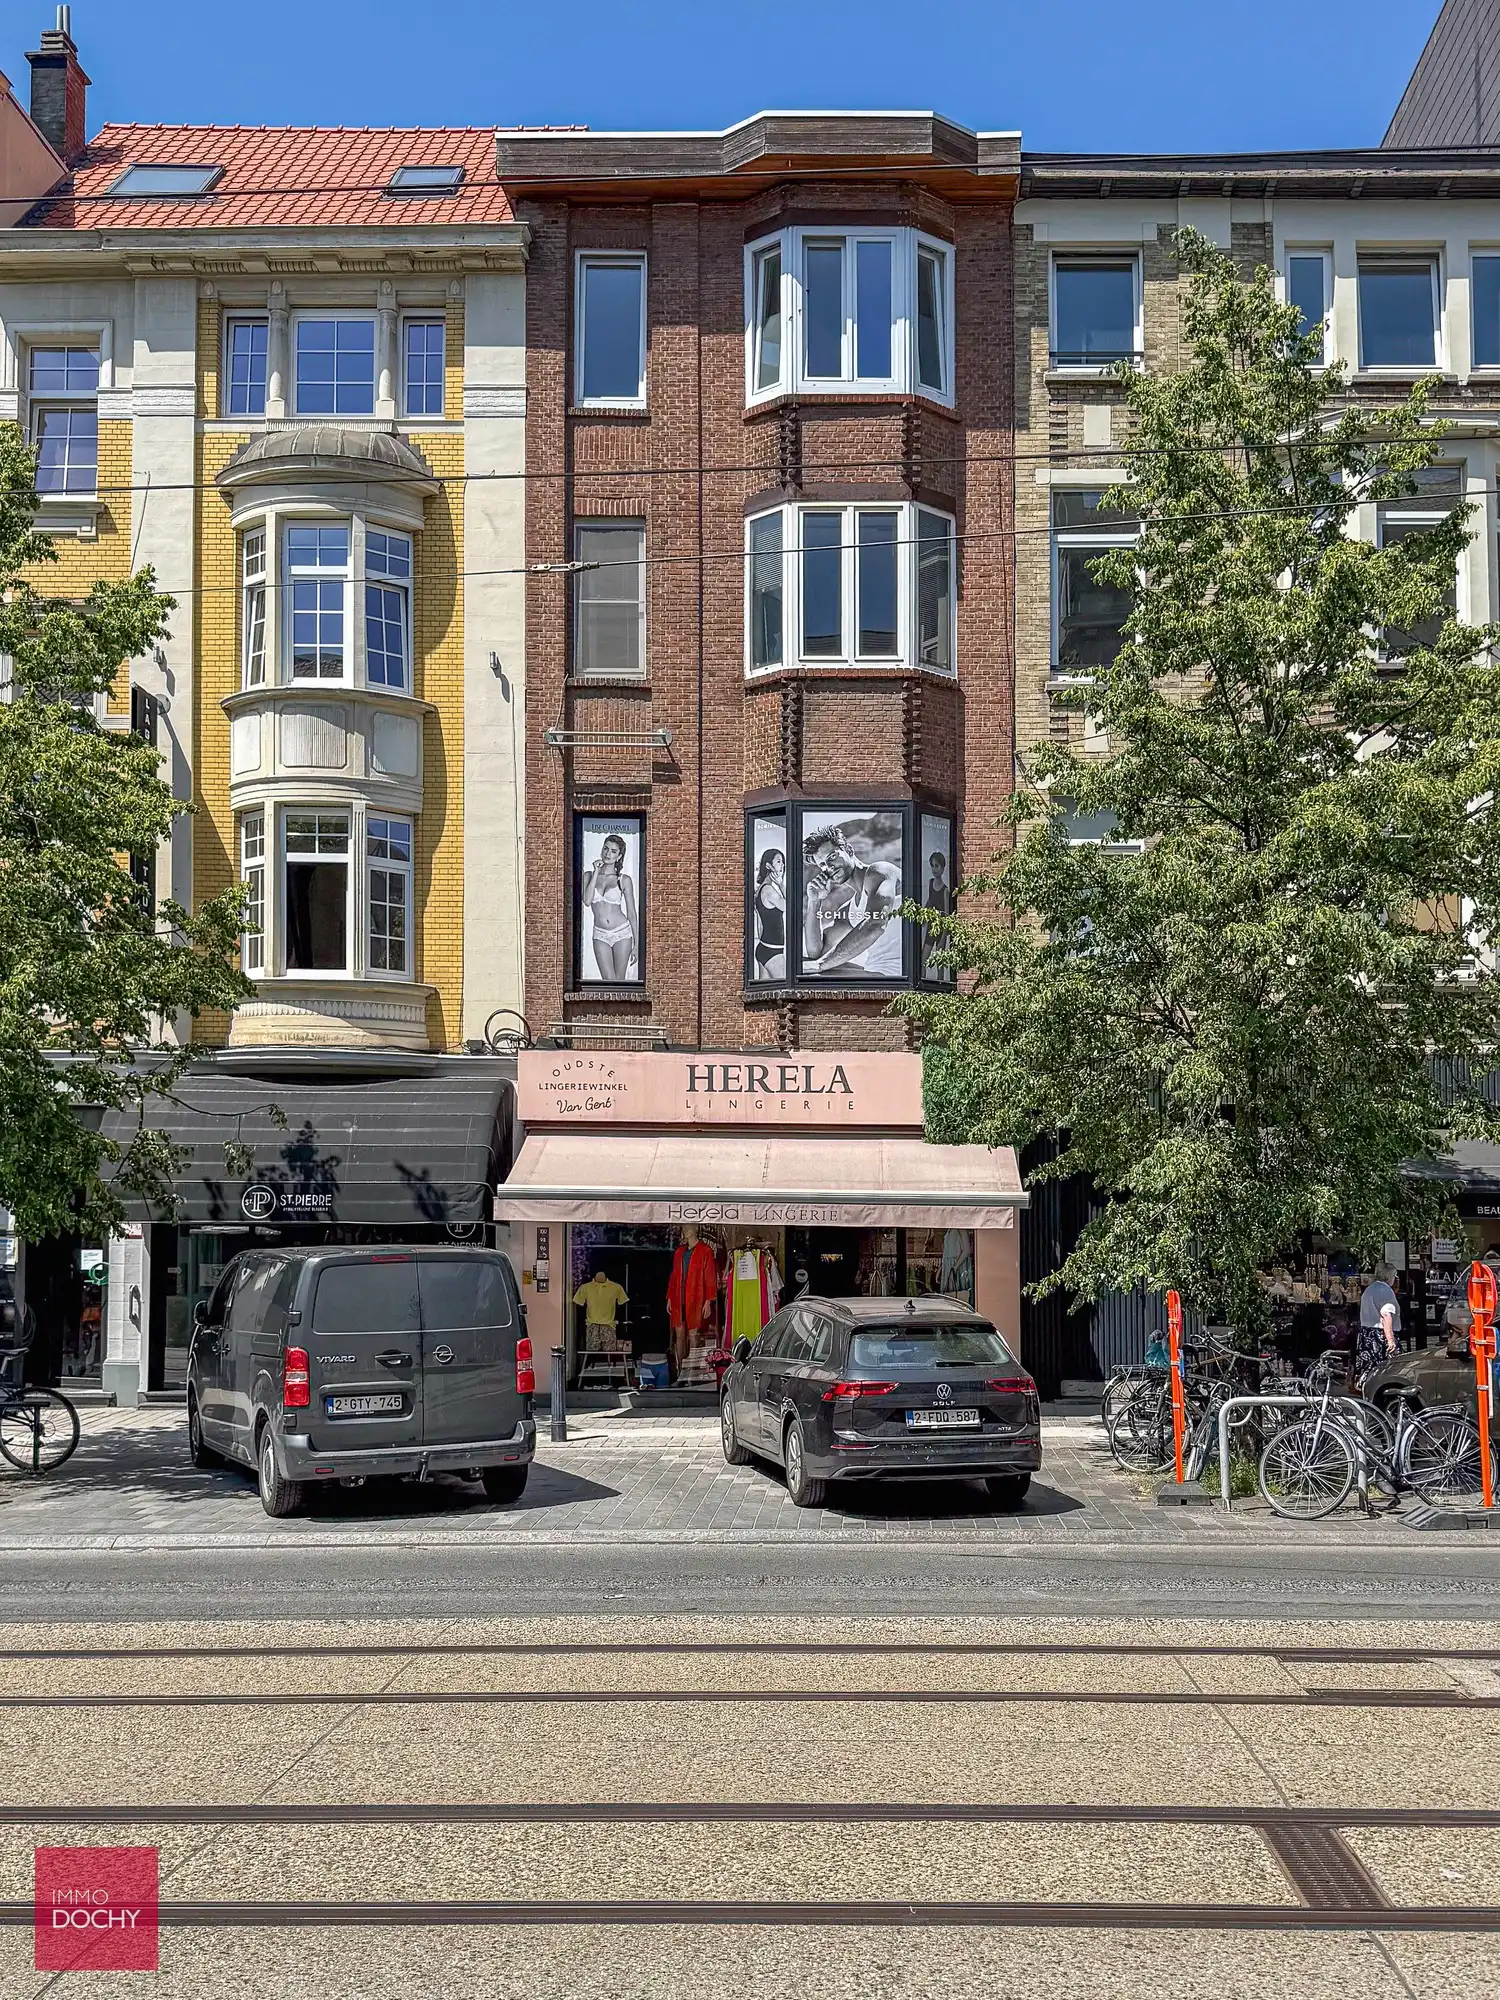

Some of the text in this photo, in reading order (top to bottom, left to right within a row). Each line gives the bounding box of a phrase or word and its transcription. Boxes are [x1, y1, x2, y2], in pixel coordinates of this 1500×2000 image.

[552, 1060, 615, 1078] OUDSTE
[539, 1083, 628, 1091] LINGERIEWINKEL
[686, 1064, 854, 1094] HERELA
[556, 1096, 612, 1114] Van Gent
[686, 1100, 854, 1110] LINGERIE
[668, 1205, 838, 1222] Herela LINGERIE
[316, 1355, 356, 1363] VIVARO
